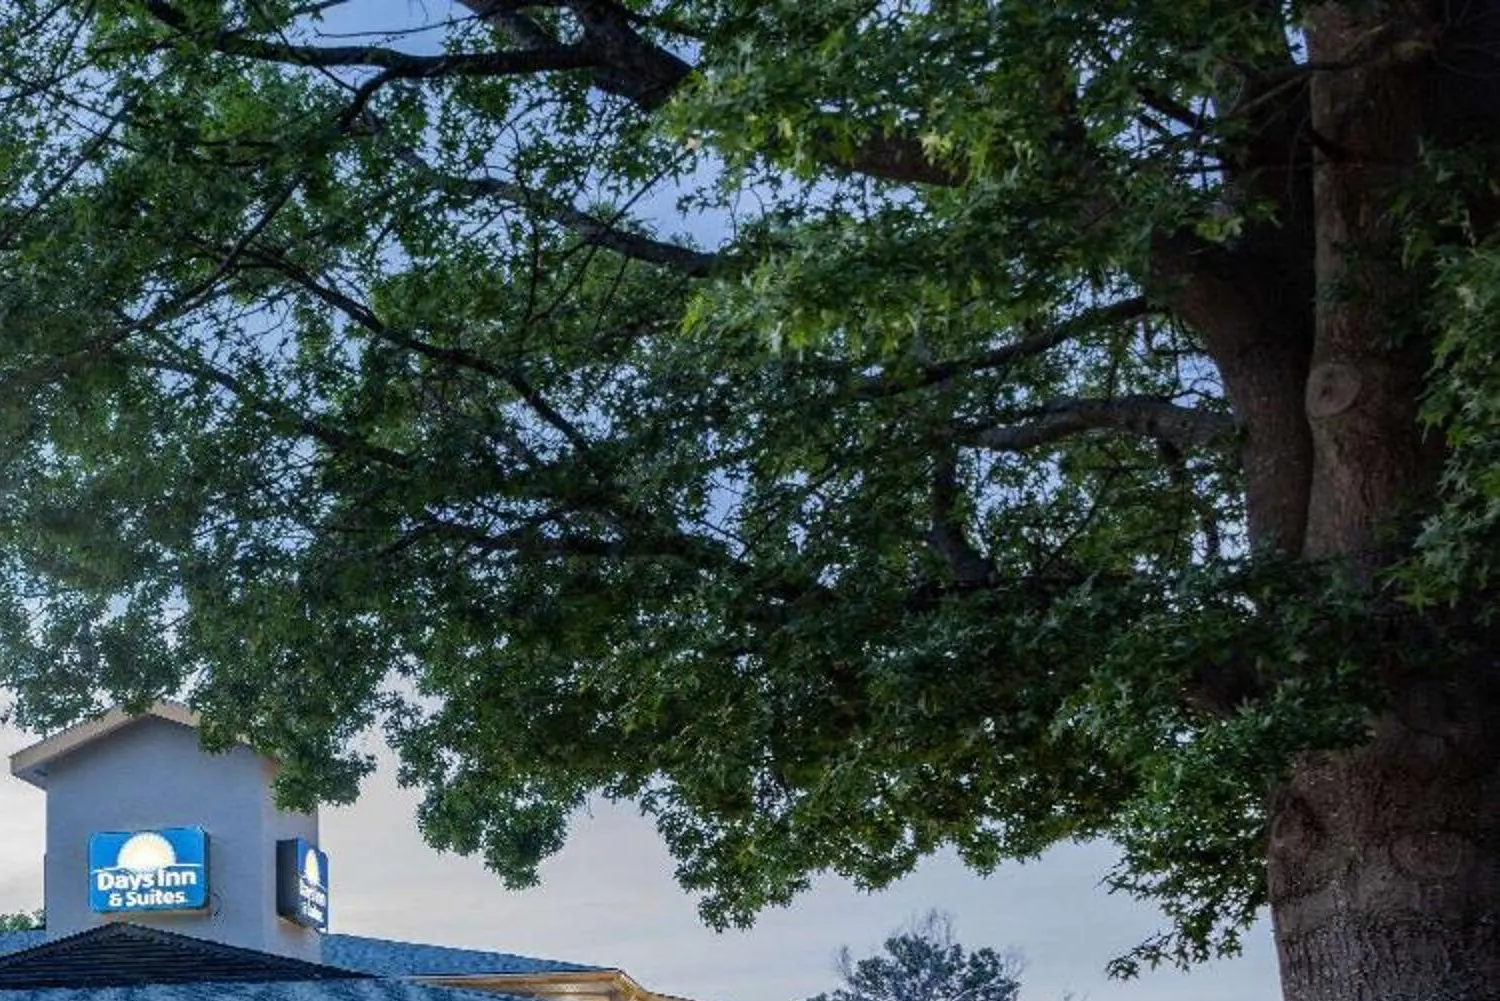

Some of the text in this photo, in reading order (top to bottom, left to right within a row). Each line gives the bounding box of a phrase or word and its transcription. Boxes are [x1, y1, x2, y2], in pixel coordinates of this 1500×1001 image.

[97, 869, 197, 891] Days Inn
[109, 889, 186, 907] & Suites
